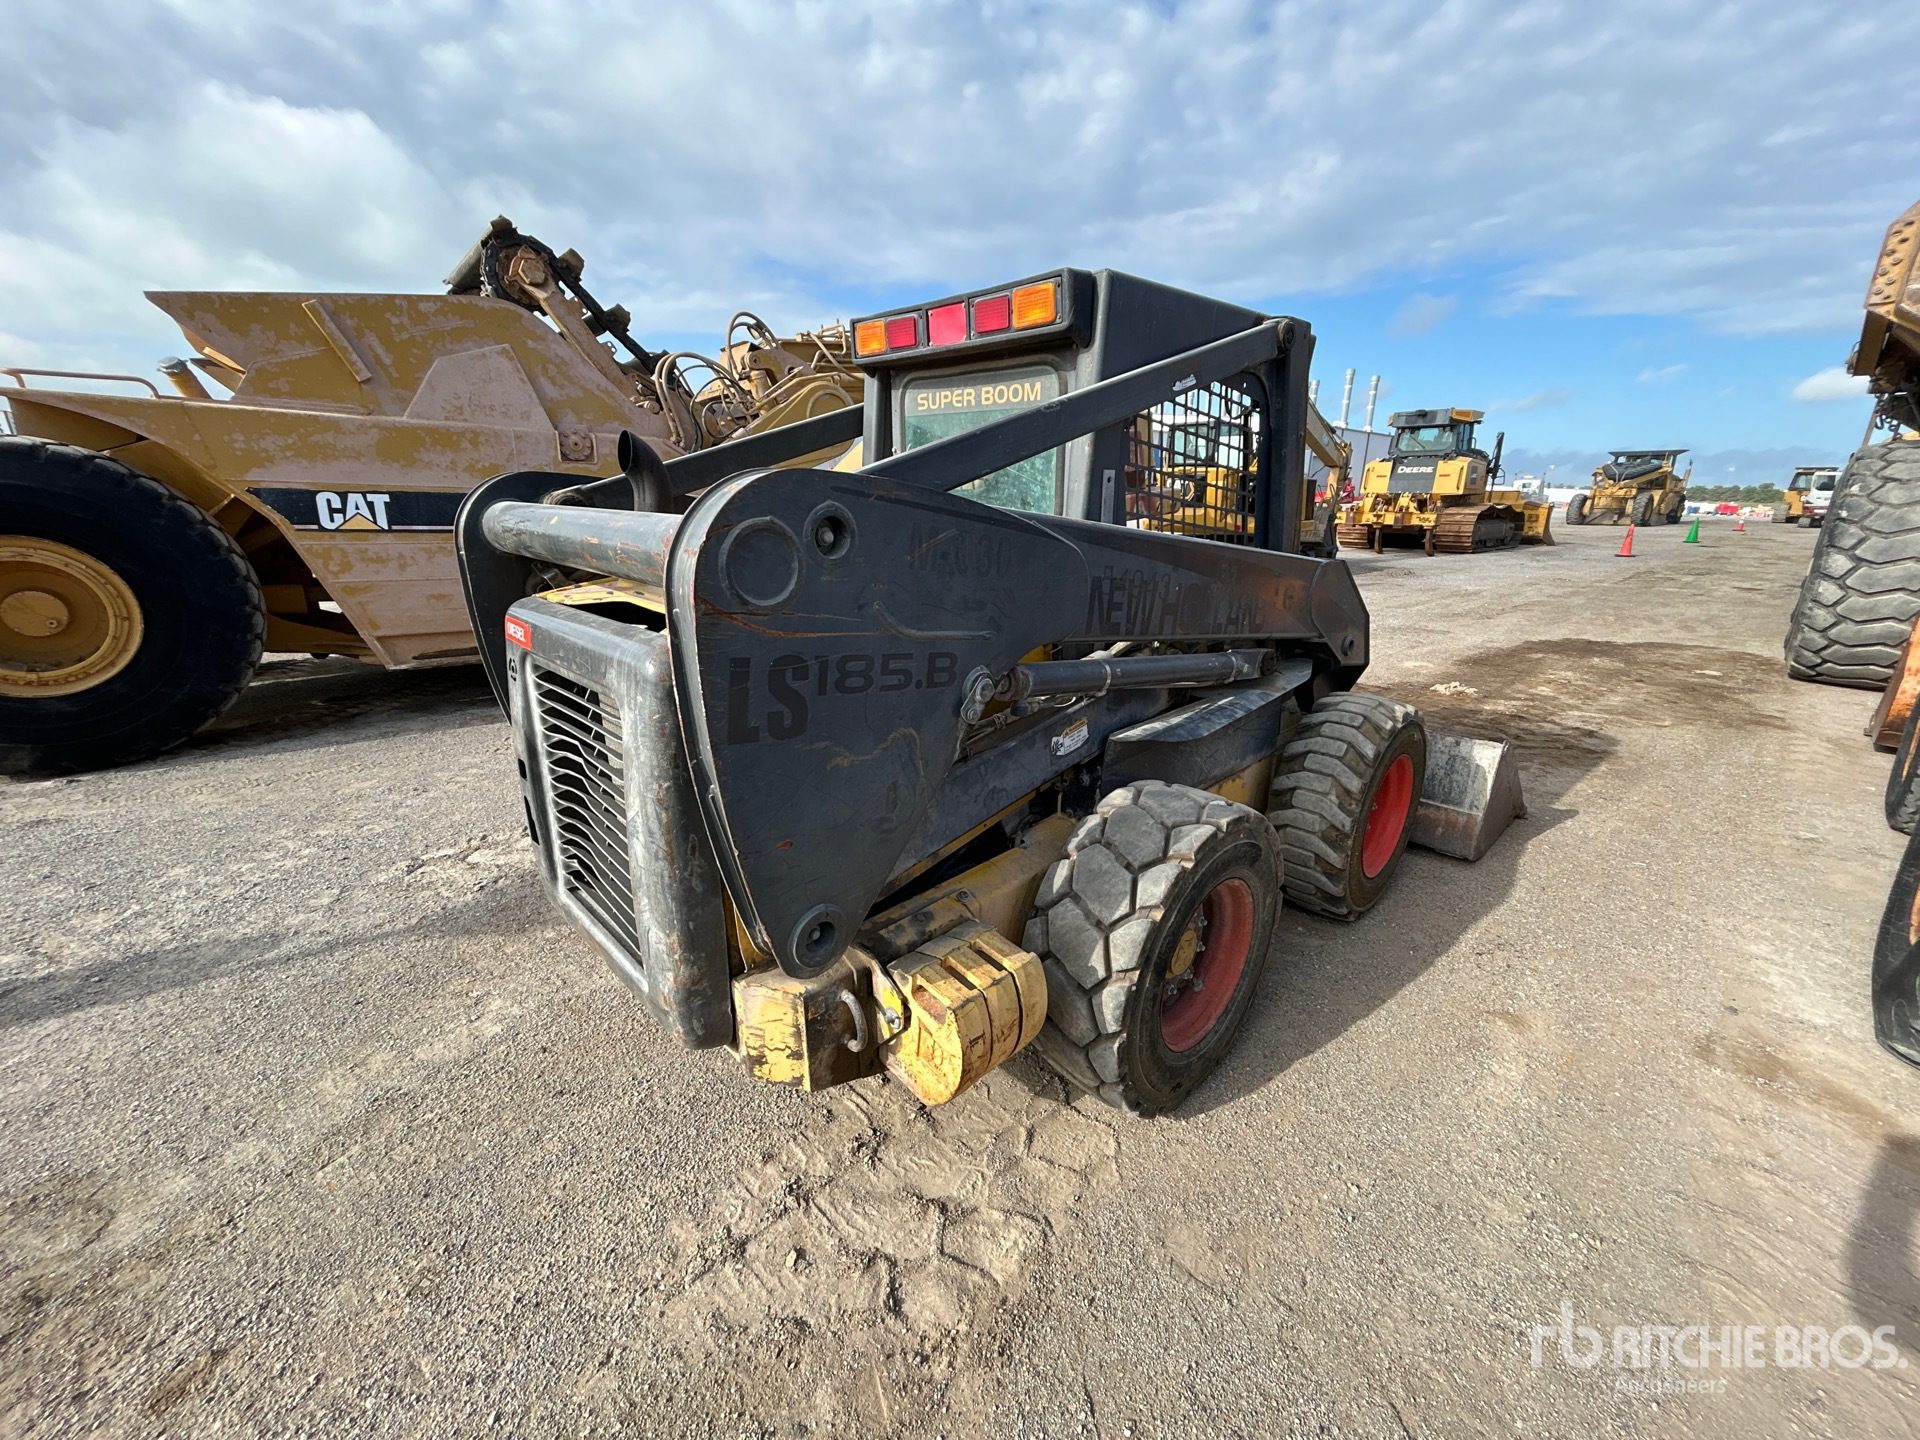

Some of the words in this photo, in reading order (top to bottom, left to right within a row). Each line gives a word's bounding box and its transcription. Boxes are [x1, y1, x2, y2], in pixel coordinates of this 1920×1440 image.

[917, 388, 976, 411] SUPER
[981, 381, 1042, 406] BOOM
[1397, 466, 1435, 474] DEERE
[315, 491, 391, 530] CAT
[1085, 575, 1159, 636] NEW
[507, 621, 526, 642] DIESEL
[727, 653, 811, 746] LS
[813, 651, 959, 697] 185.B
